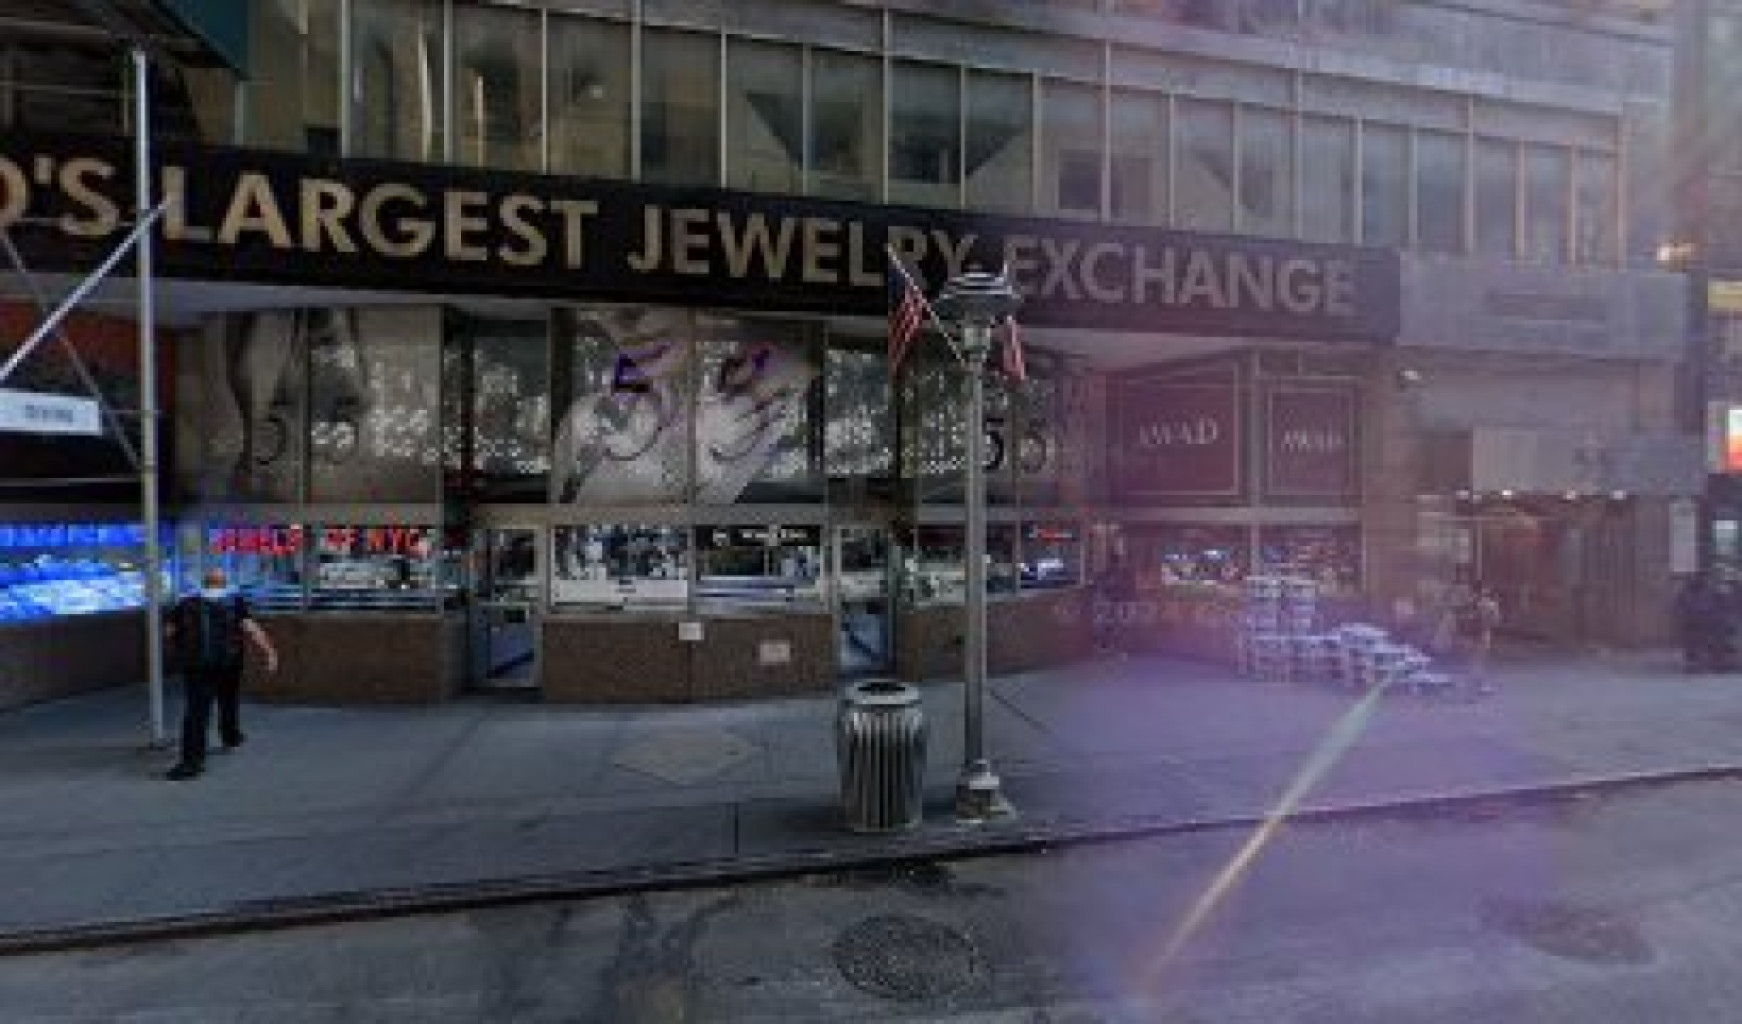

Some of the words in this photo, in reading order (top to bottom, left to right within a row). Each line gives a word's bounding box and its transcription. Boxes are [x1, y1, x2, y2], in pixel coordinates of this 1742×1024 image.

[161, 165, 599, 270] LARGEST
[627, 203, 979, 291] JEWELRY
[1004, 234, 1355, 317] EXCHANGE
